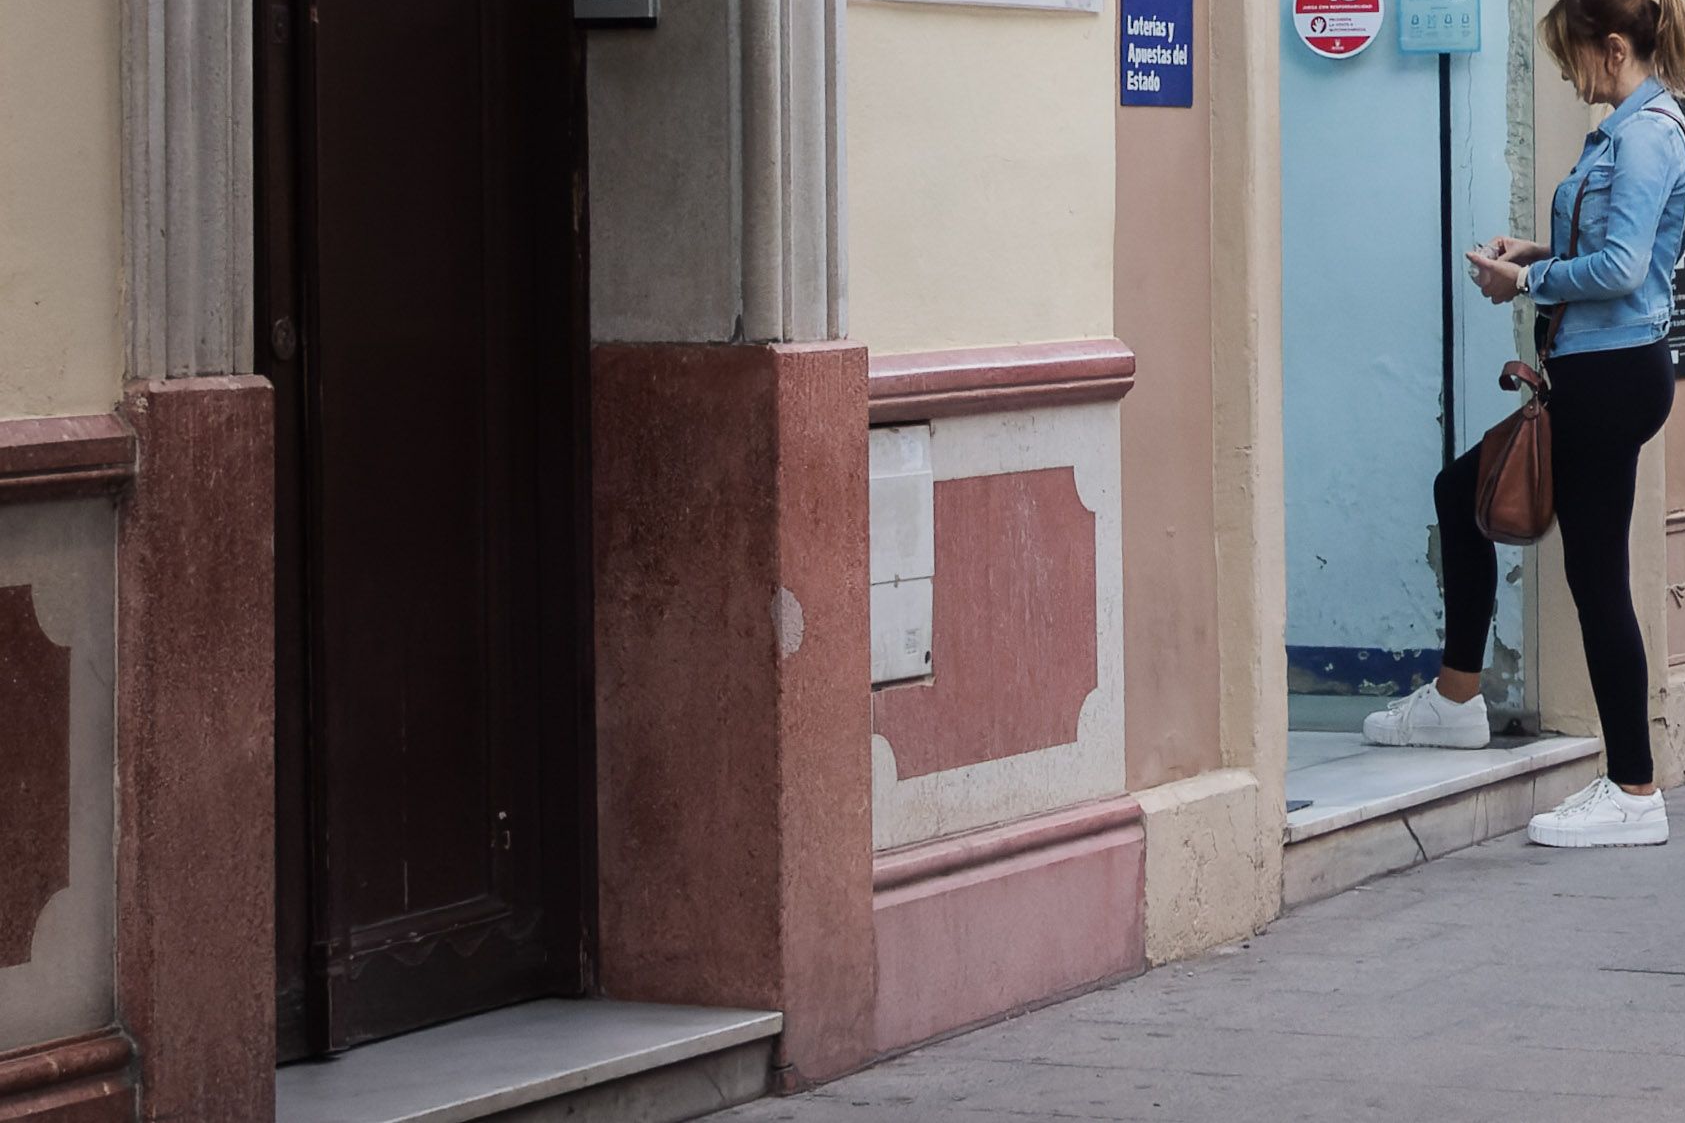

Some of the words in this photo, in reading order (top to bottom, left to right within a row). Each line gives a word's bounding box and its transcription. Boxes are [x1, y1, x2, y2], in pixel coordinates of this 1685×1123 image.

[1127, 15, 1166, 38] Loterías
[1167, 22, 1175, 44] y
[1127, 43, 1172, 69] Apuestas
[1173, 44, 1187, 66] del
[1127, 69, 1161, 93] Estado
